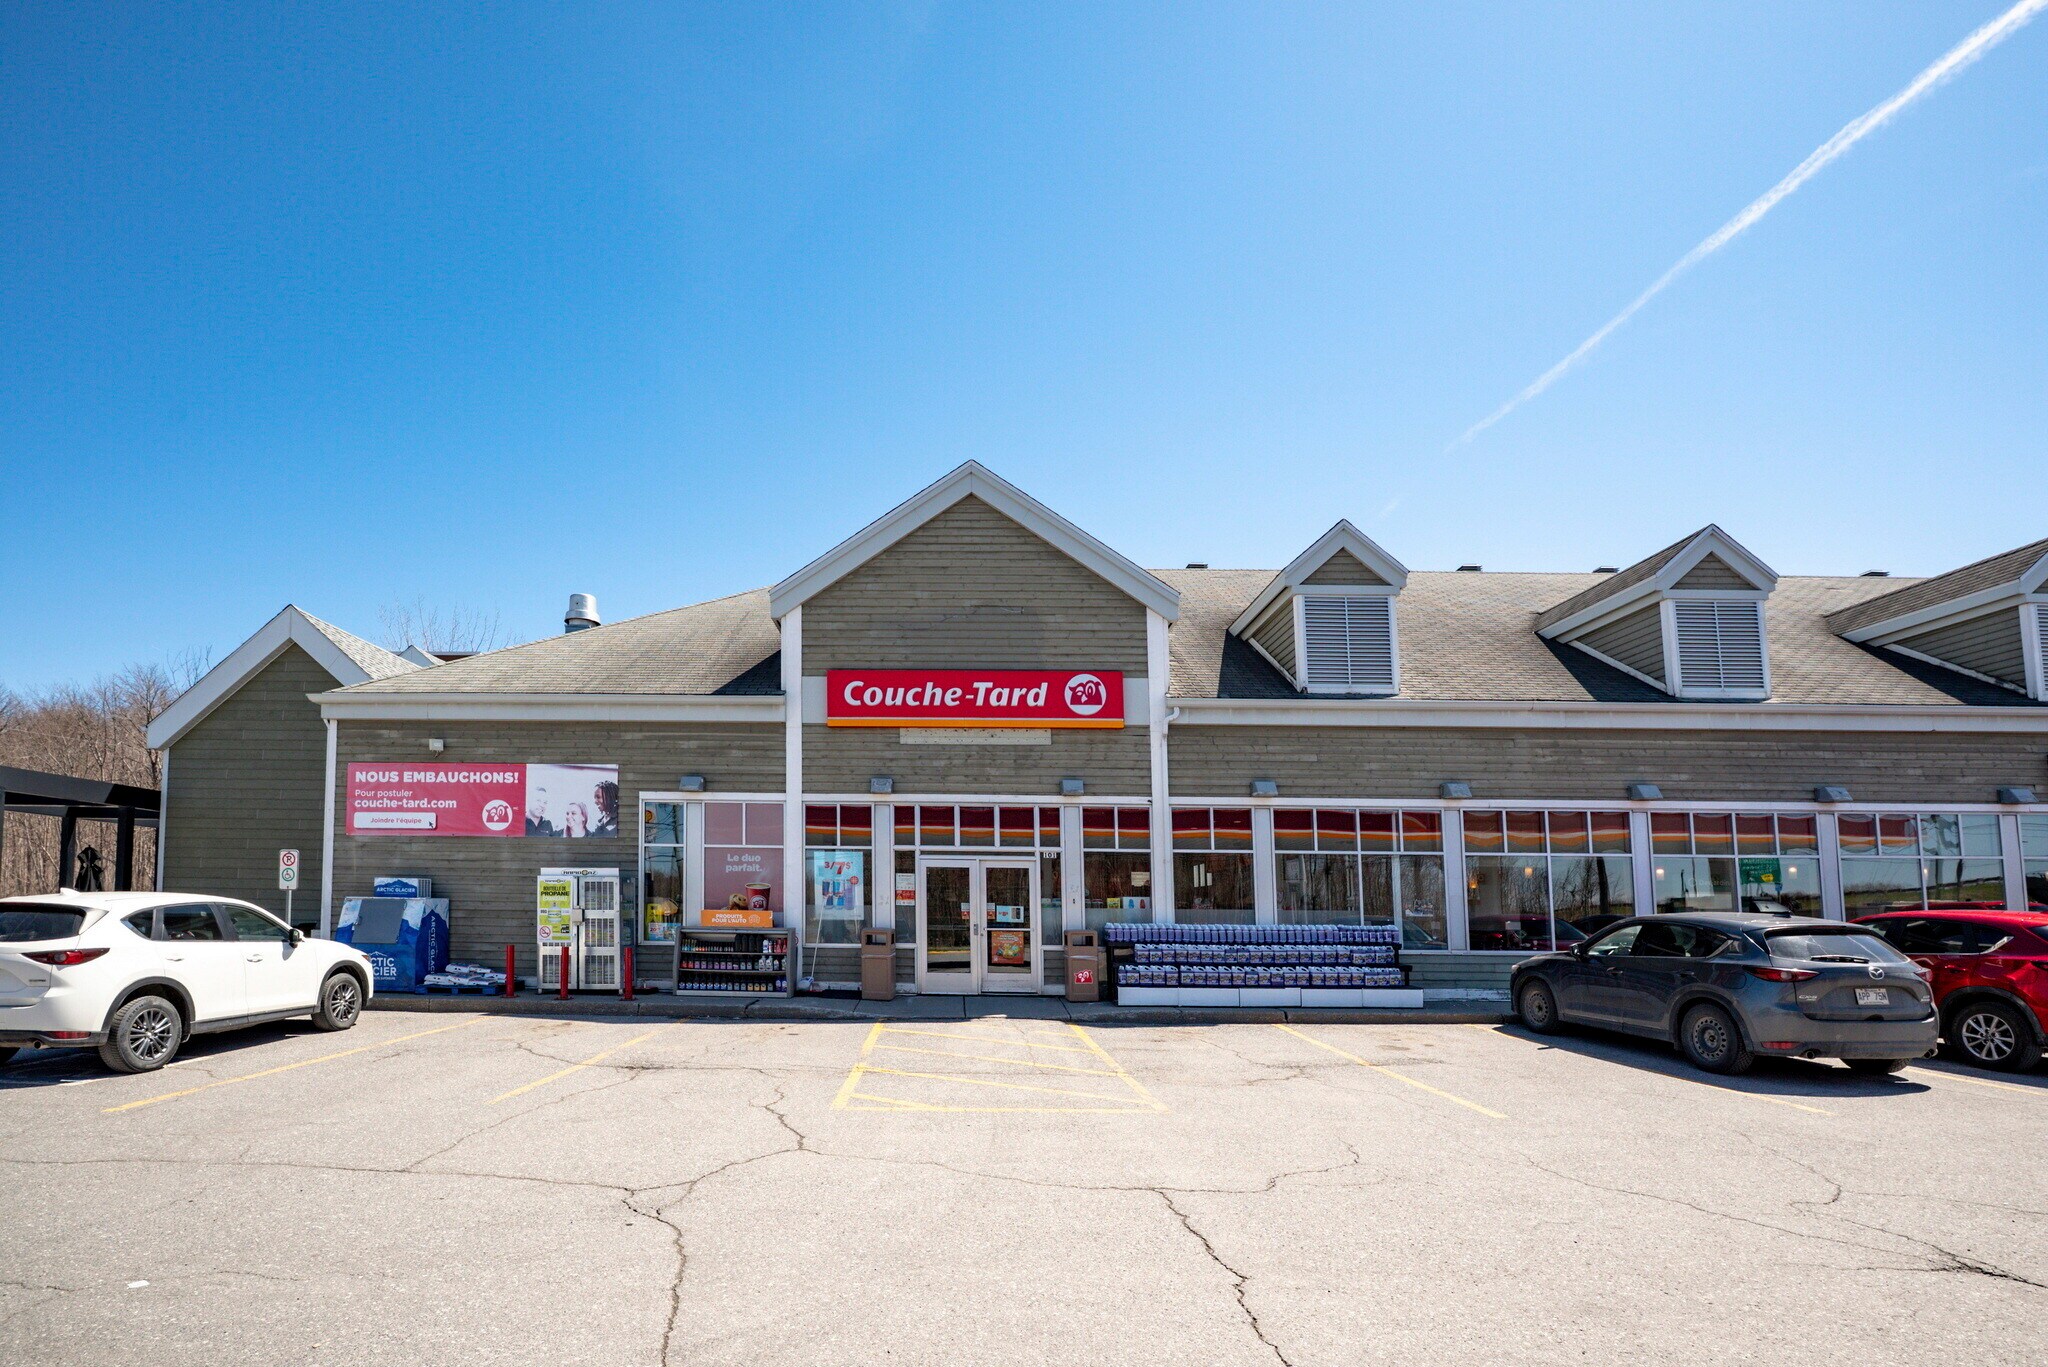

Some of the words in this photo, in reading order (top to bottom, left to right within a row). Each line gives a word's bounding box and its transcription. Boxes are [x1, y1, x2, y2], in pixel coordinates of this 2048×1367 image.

[844, 681, 1048, 707] Couche-Tard
[355, 771, 399, 783] NOUS
[403, 772, 519, 783] EMBAUCHONS!
[355, 789, 375, 797] Pour
[377, 789, 413, 798] postuler
[354, 798, 457, 808] couche-tard.com
[727, 853, 739, 862] Le
[741, 853, 761, 862] duo
[726, 864, 762, 873] parfait.
[371, 957, 395, 967] CTIC
[373, 966, 397, 976] CIER
